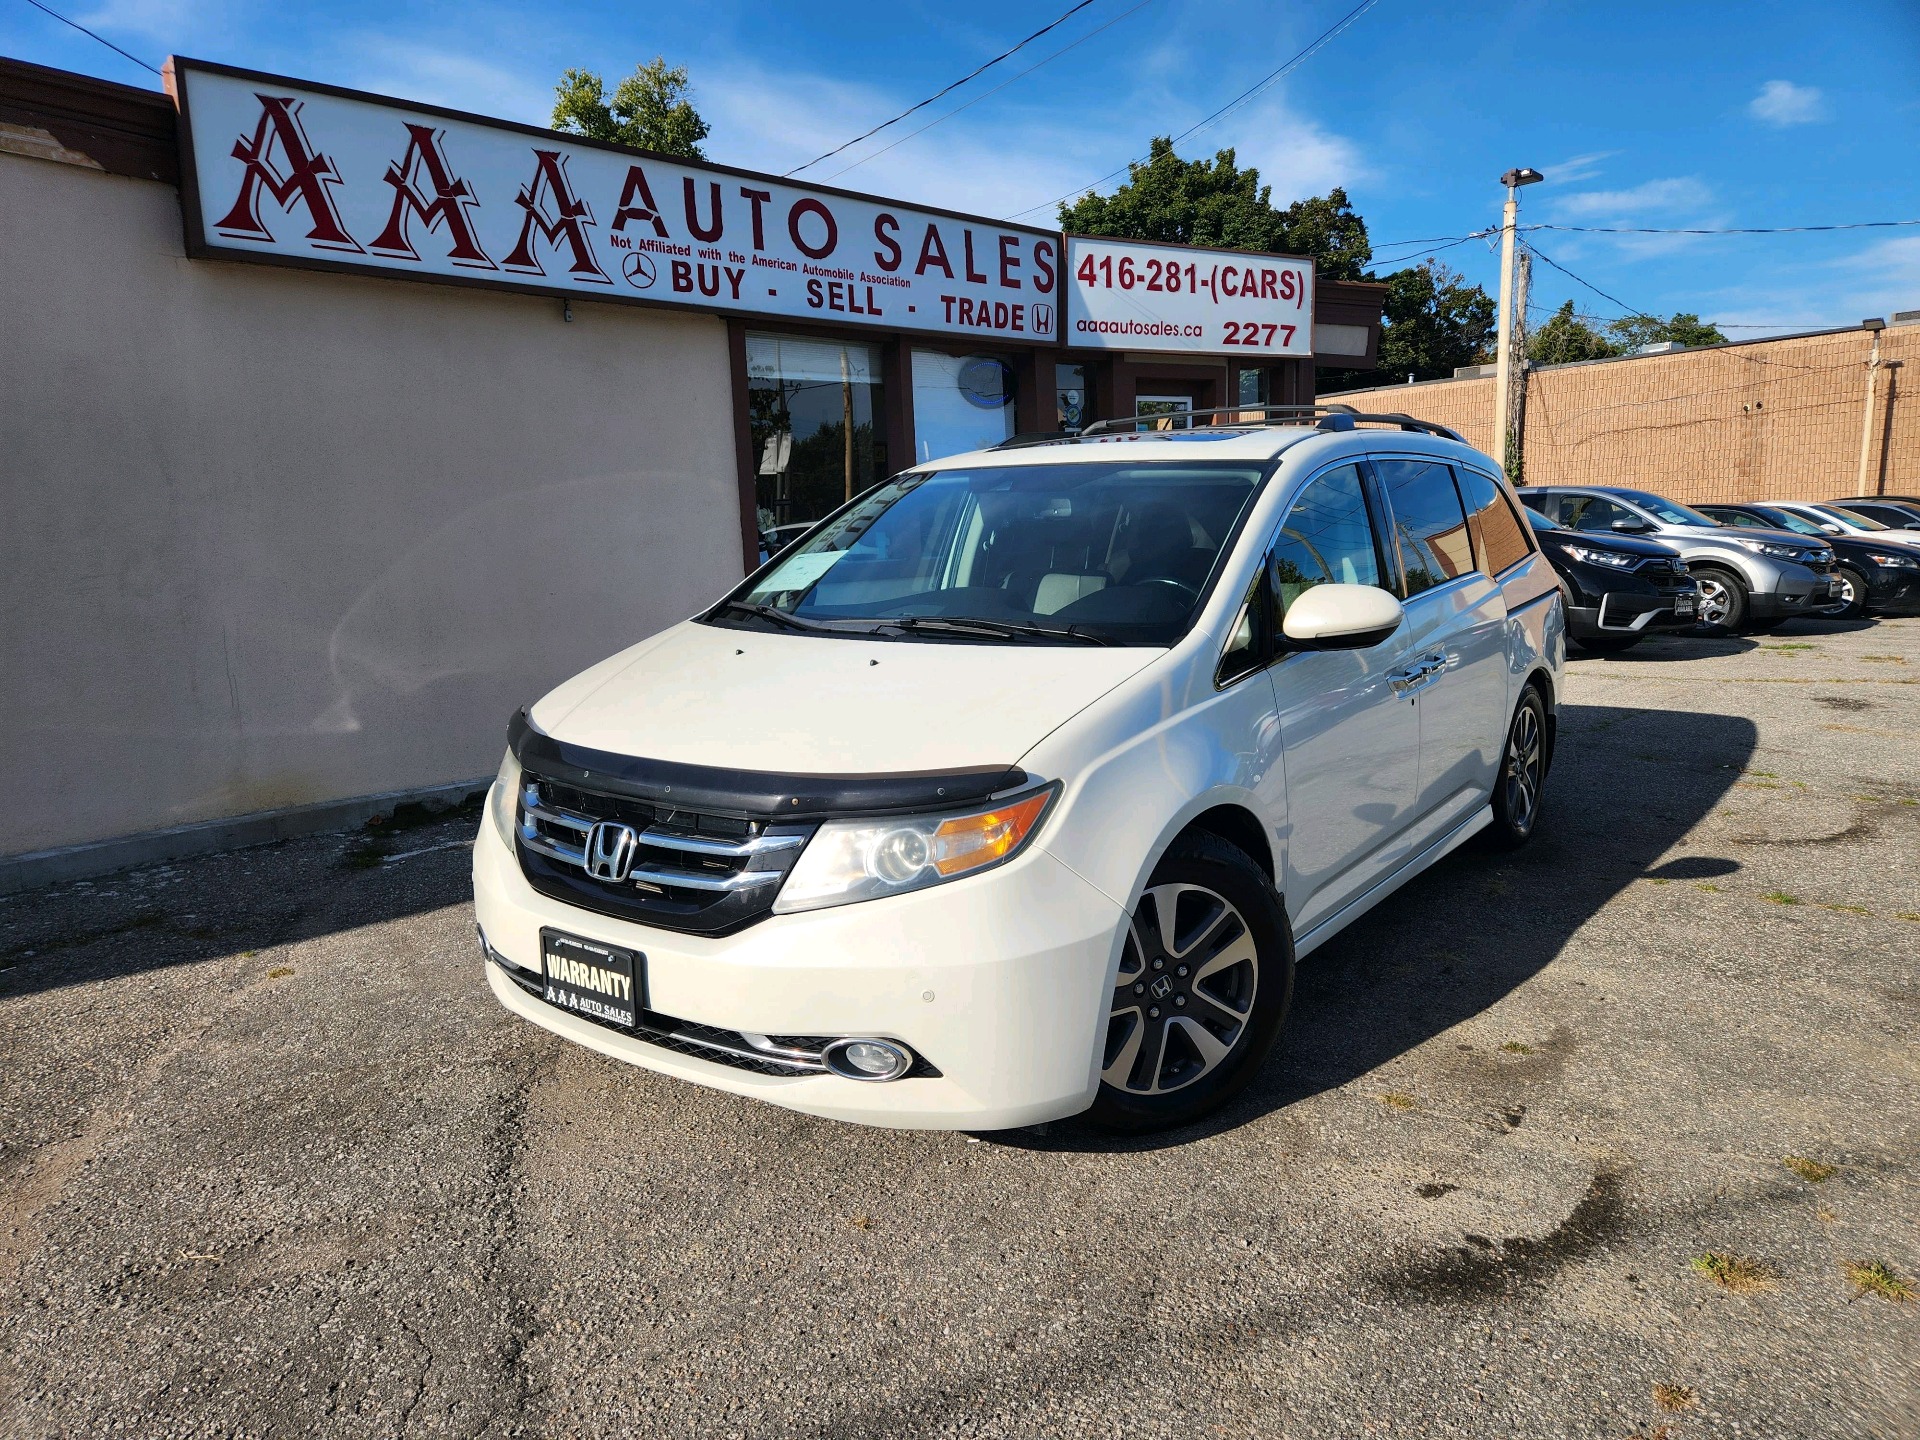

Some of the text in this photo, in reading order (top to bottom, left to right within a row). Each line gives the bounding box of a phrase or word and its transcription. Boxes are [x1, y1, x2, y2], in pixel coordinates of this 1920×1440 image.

[611, 165, 838, 260] AUTO
[874, 213, 1055, 294] SALES
[610, 234, 911, 288] Not Affiliated with the American Automobile Association
[1077, 253, 1304, 310] 416-281-(CARS)
[671, 260, 1025, 332] BUY SELL TRADE
[1077, 319, 1203, 338] aaaautosales.ca
[1222, 322, 1297, 347] 2277
[546, 953, 631, 1001] WARRANTY
[580, 997, 602, 1012] AUTO
[603, 1004, 632, 1022] SALES
